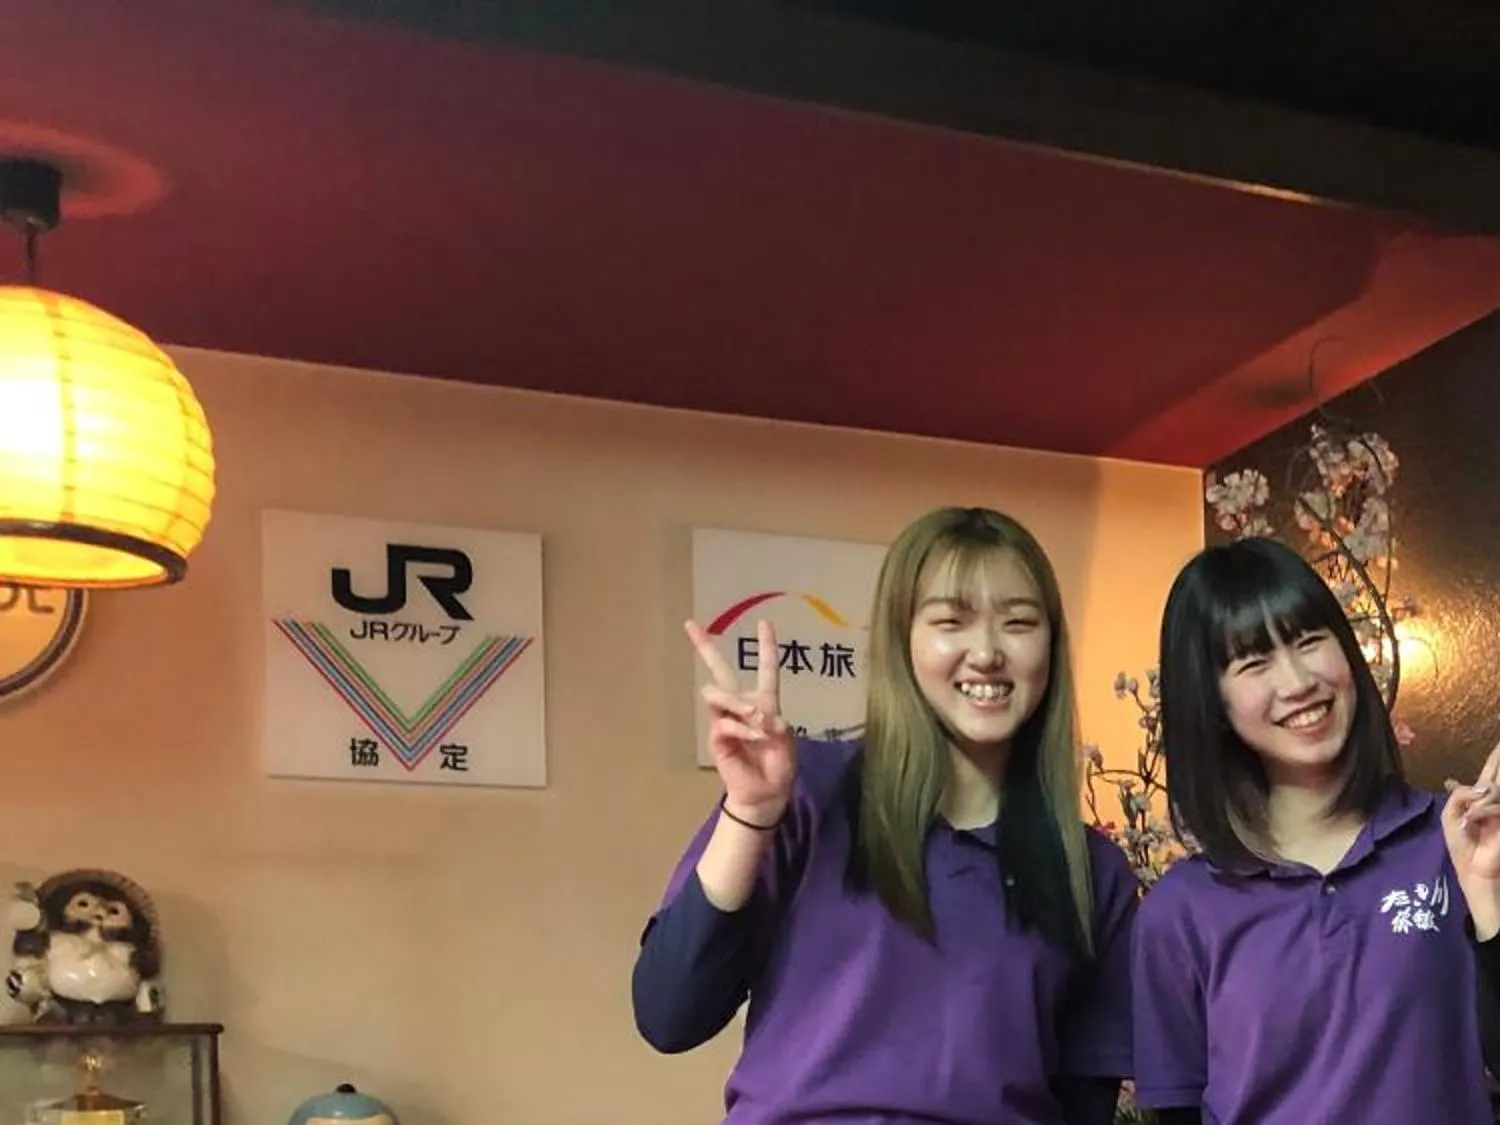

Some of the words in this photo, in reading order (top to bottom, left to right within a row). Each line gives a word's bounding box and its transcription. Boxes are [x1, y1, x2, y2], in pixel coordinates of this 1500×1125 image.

[331, 543, 475, 621] JR
[350, 619, 461, 645] JRグループ
